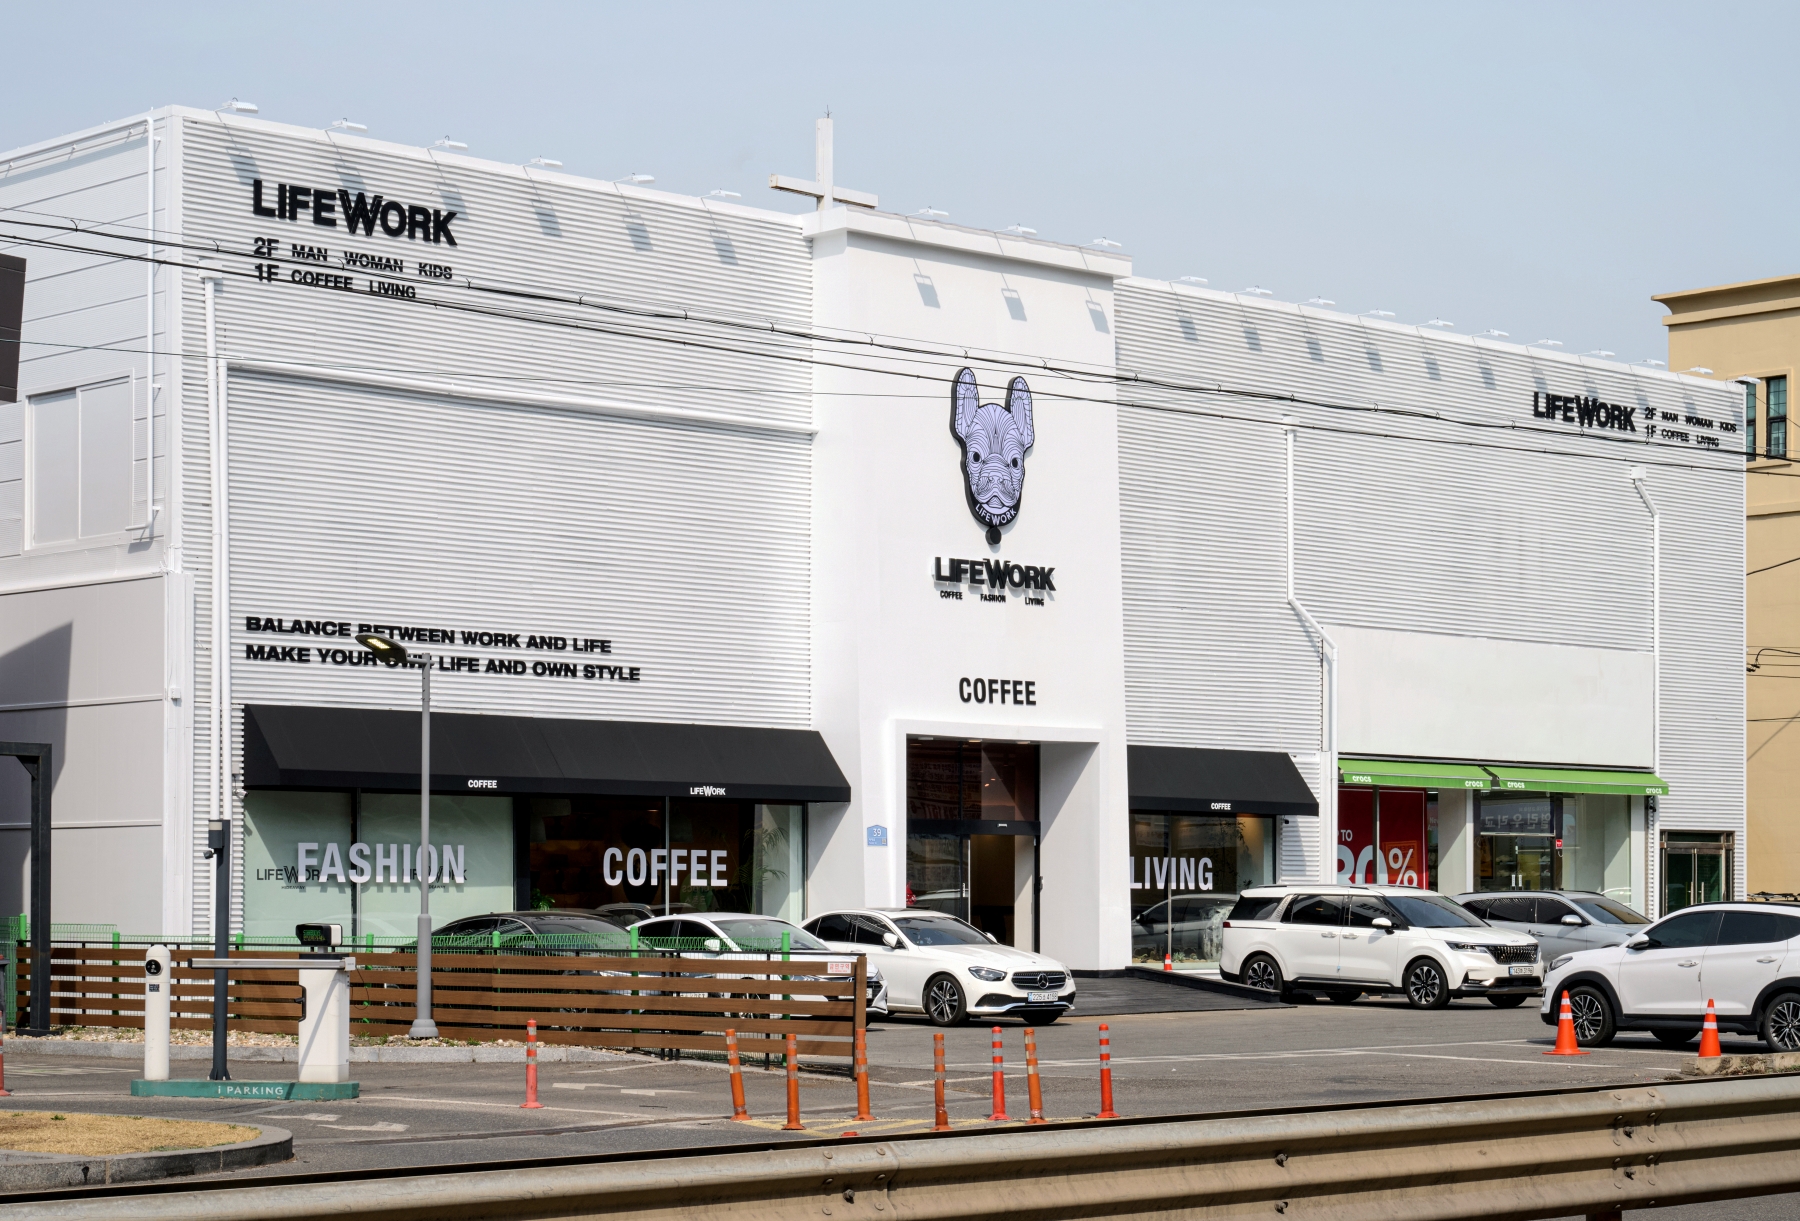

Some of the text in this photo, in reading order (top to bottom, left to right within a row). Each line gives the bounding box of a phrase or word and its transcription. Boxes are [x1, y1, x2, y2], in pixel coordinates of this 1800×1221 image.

[253, 179, 458, 246] LIFEWORK
[254, 237, 453, 280] 2F MAN WOMAN KIDS
[255, 263, 416, 299] 1F COFFEE LIVING
[1533, 391, 1637, 432] LIFEWORK
[1644, 407, 1737, 433] 2F MAN WOMAN KIDS
[1644, 425, 1720, 447] 1F COFFEE LIVING
[975, 503, 1017, 526] LIFEWORK
[934, 556, 1057, 591] LIFEWORK
[940, 590, 1044, 607] COFFEE FASHION LIVING
[245, 616, 351, 637] BALANCE
[461, 630, 521, 648] WORK
[526, 635, 567, 651] AND
[573, 638, 612, 654] LIFE
[245, 645, 311, 662] MAKE
[317, 648, 378, 666] YOUR
[439, 655, 480, 674] LIFE
[485, 659, 527, 675] AND
[532, 661, 577, 678] OWN
[583, 664, 640, 682] STYLE
[959, 677, 1037, 706] COFFEE
[468, 779, 498, 789] COFFEE
[1352, 775, 1372, 783] crocs
[1464, 780, 1484, 788] crocs
[1507, 780, 1525, 789] crocs
[1645, 786, 1663, 794] crocs
[690, 785, 726, 797] LIFEWORK
[1211, 802, 1232, 811] COFFEE
[873, 828, 882, 837] 39
[1340, 829, 1353, 841] TO
[297, 842, 465, 884] FASHION
[602, 847, 728, 887] COFFEE
[1130, 856, 1214, 891] LIVING
[257, 866, 329, 883] LIFEWOR
[227, 1086, 284, 1096] PARKING
